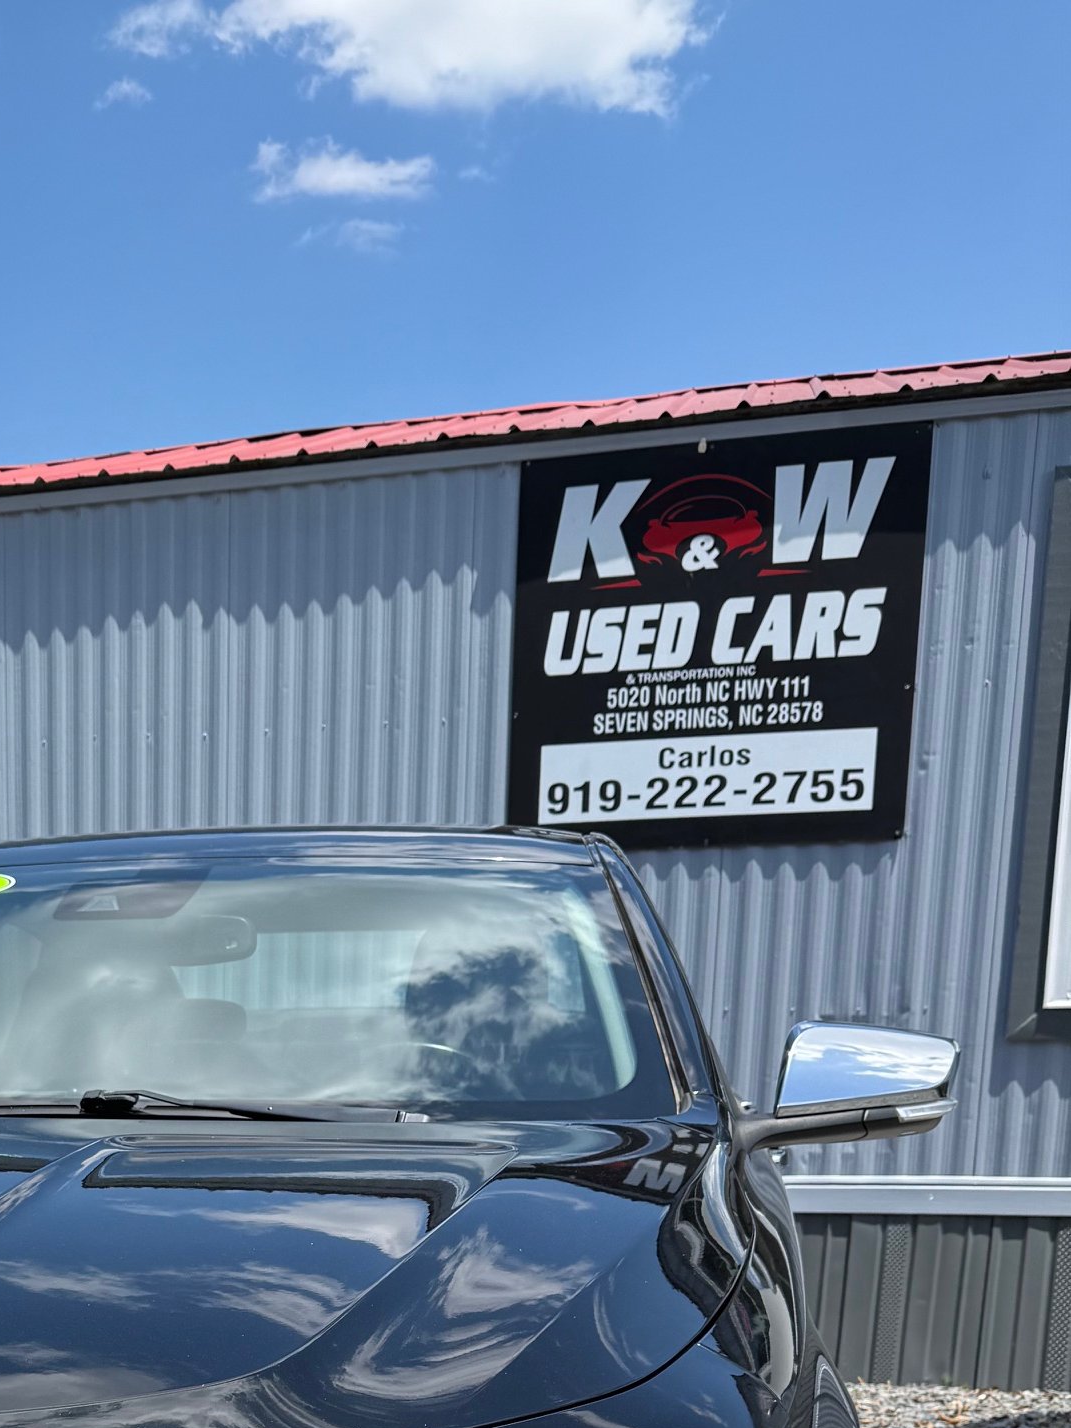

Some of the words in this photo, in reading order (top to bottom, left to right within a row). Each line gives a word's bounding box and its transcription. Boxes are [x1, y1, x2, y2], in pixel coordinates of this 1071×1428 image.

[547, 478, 652, 583] K
[681, 534, 719, 572] &
[772, 456, 897, 564] W
[544, 601, 700, 677] USED
[711, 587, 887, 666] CARS
[637, 666, 734, 683] TRANSPORTATION
[736, 665, 757, 677] INC
[606, 685, 650, 709] 5020
[654, 681, 702, 706] North
[705, 680, 730, 702] NC
[733, 677, 778, 701] HWY
[780, 675, 811, 698] 111
[593, 710, 649, 735] SEVEN
[652, 705, 734, 731] SPRINGS,
[738, 704, 764, 726] NC
[766, 700, 824, 725] 28578
[658, 745, 752, 769] Carlos
[547, 768, 866, 816] 919-222-2755
